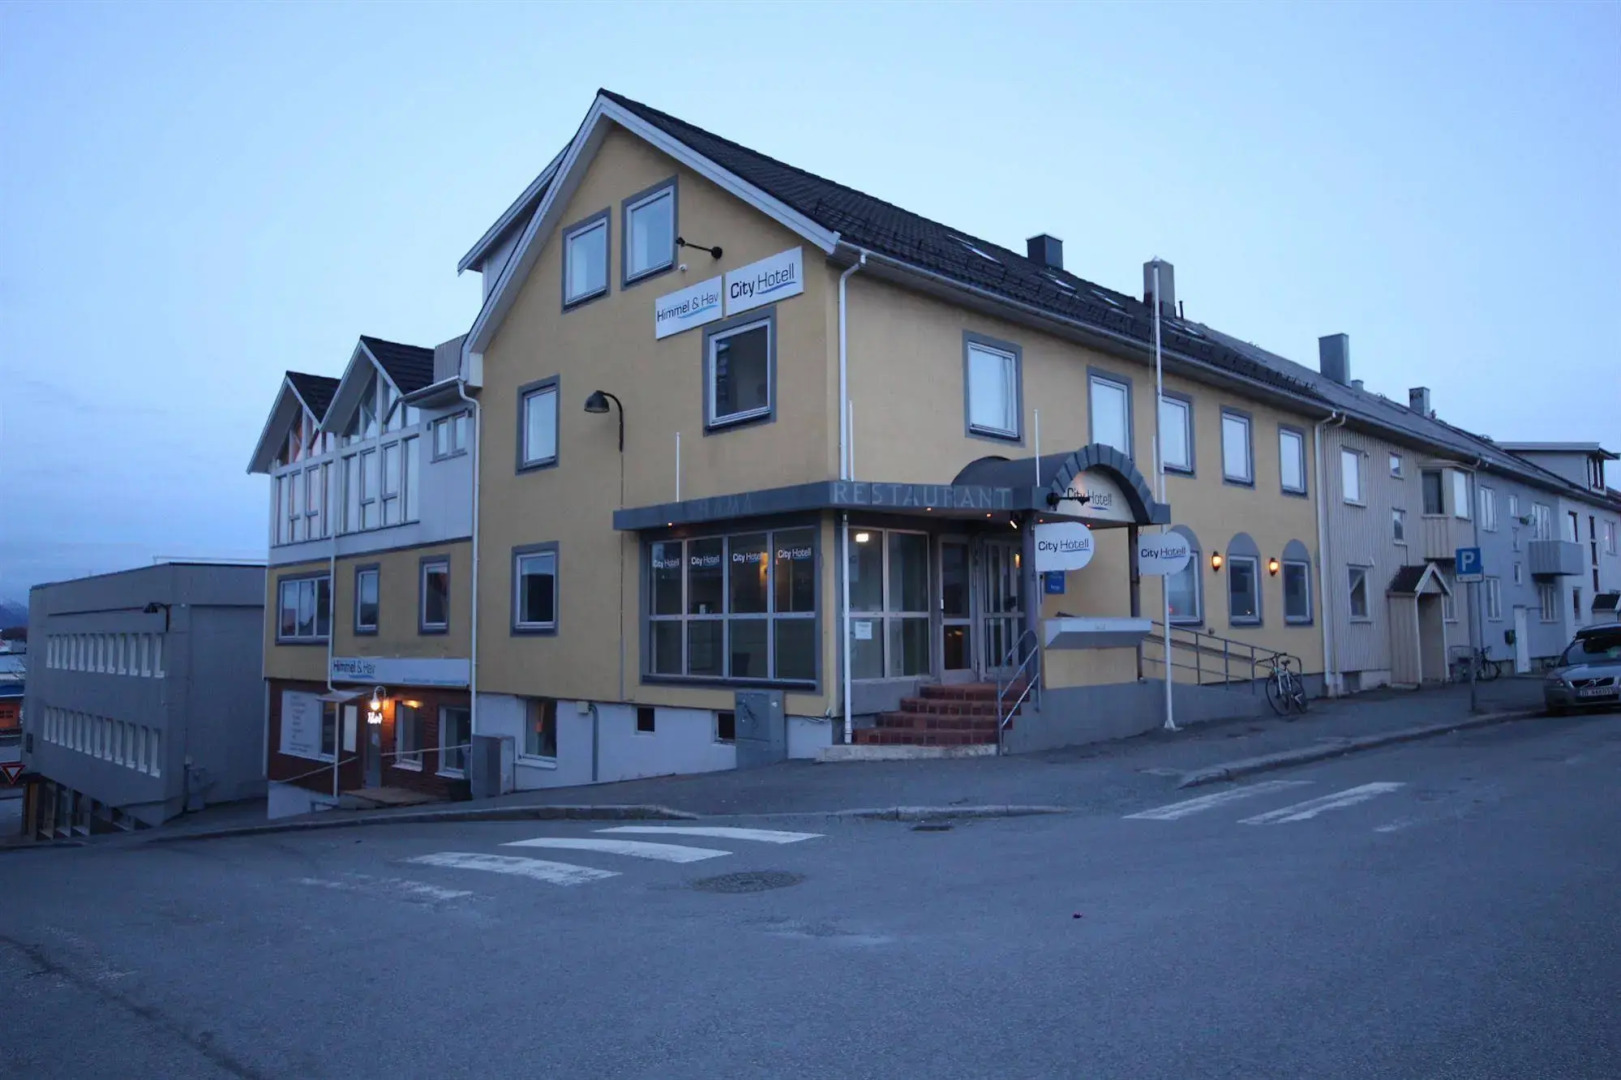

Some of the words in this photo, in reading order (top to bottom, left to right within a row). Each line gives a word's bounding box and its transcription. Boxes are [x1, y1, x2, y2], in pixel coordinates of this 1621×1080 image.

[730, 280, 755, 299] City
[757, 263, 795, 291] Hotell
[656, 301, 690, 322] Himmel
[691, 297, 699, 310] &
[701, 291, 719, 307] Hav
[833, 482, 1012, 509] RESTAURANT
[1087, 489, 1112, 506] Hotell
[778, 549, 791, 560] City
[792, 547, 811, 557] Hotell
[1038, 541, 1059, 553] City
[1060, 539, 1089, 550] Hotell
[1141, 548, 1159, 559] City
[1160, 547, 1186, 557] Hotell
[732, 553, 745, 563] City
[1461, 551, 1475, 571] P
[333, 660, 356, 673] Himmel
